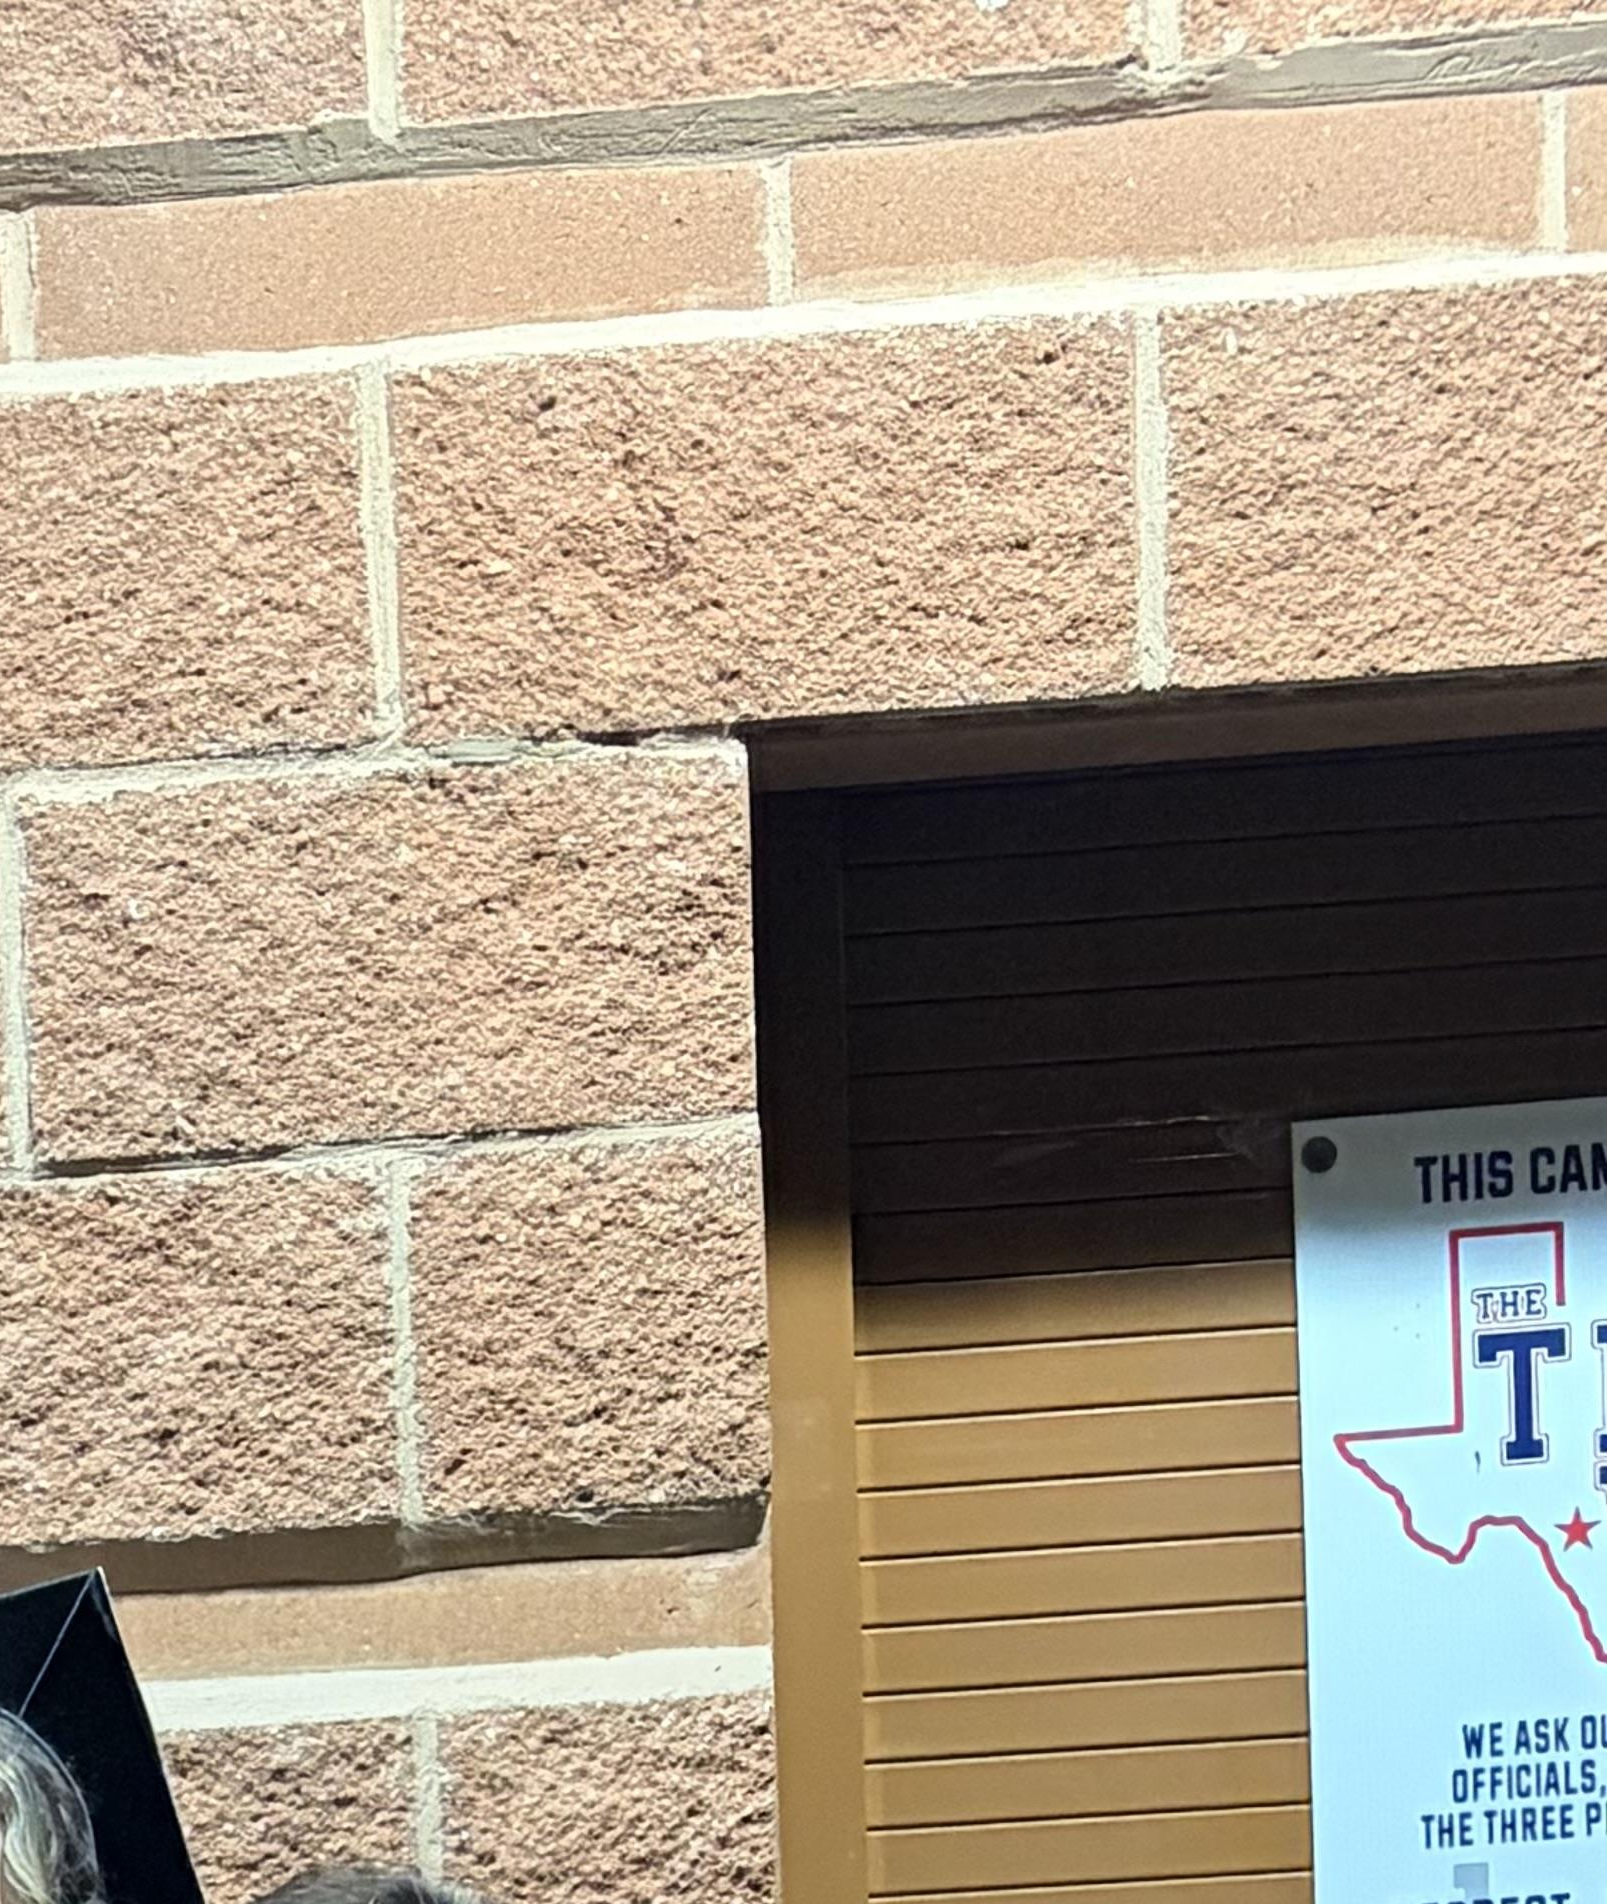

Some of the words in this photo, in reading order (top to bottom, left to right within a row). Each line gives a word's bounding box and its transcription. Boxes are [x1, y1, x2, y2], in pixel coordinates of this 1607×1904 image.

[1414, 1150, 1514, 1204] THIS
[1474, 1288, 1542, 1320] THE
[1475, 1324, 1607, 1463] T
[1462, 1721, 1504, 1759] WE
[1514, 1717, 1569, 1755] ASK
[1452, 1759, 1606, 1804] OFFICIALS,
[1421, 1812, 1474, 1849] THE
[1483, 1804, 1574, 1845] THREE
[1585, 1802, 1607, 1837] P
